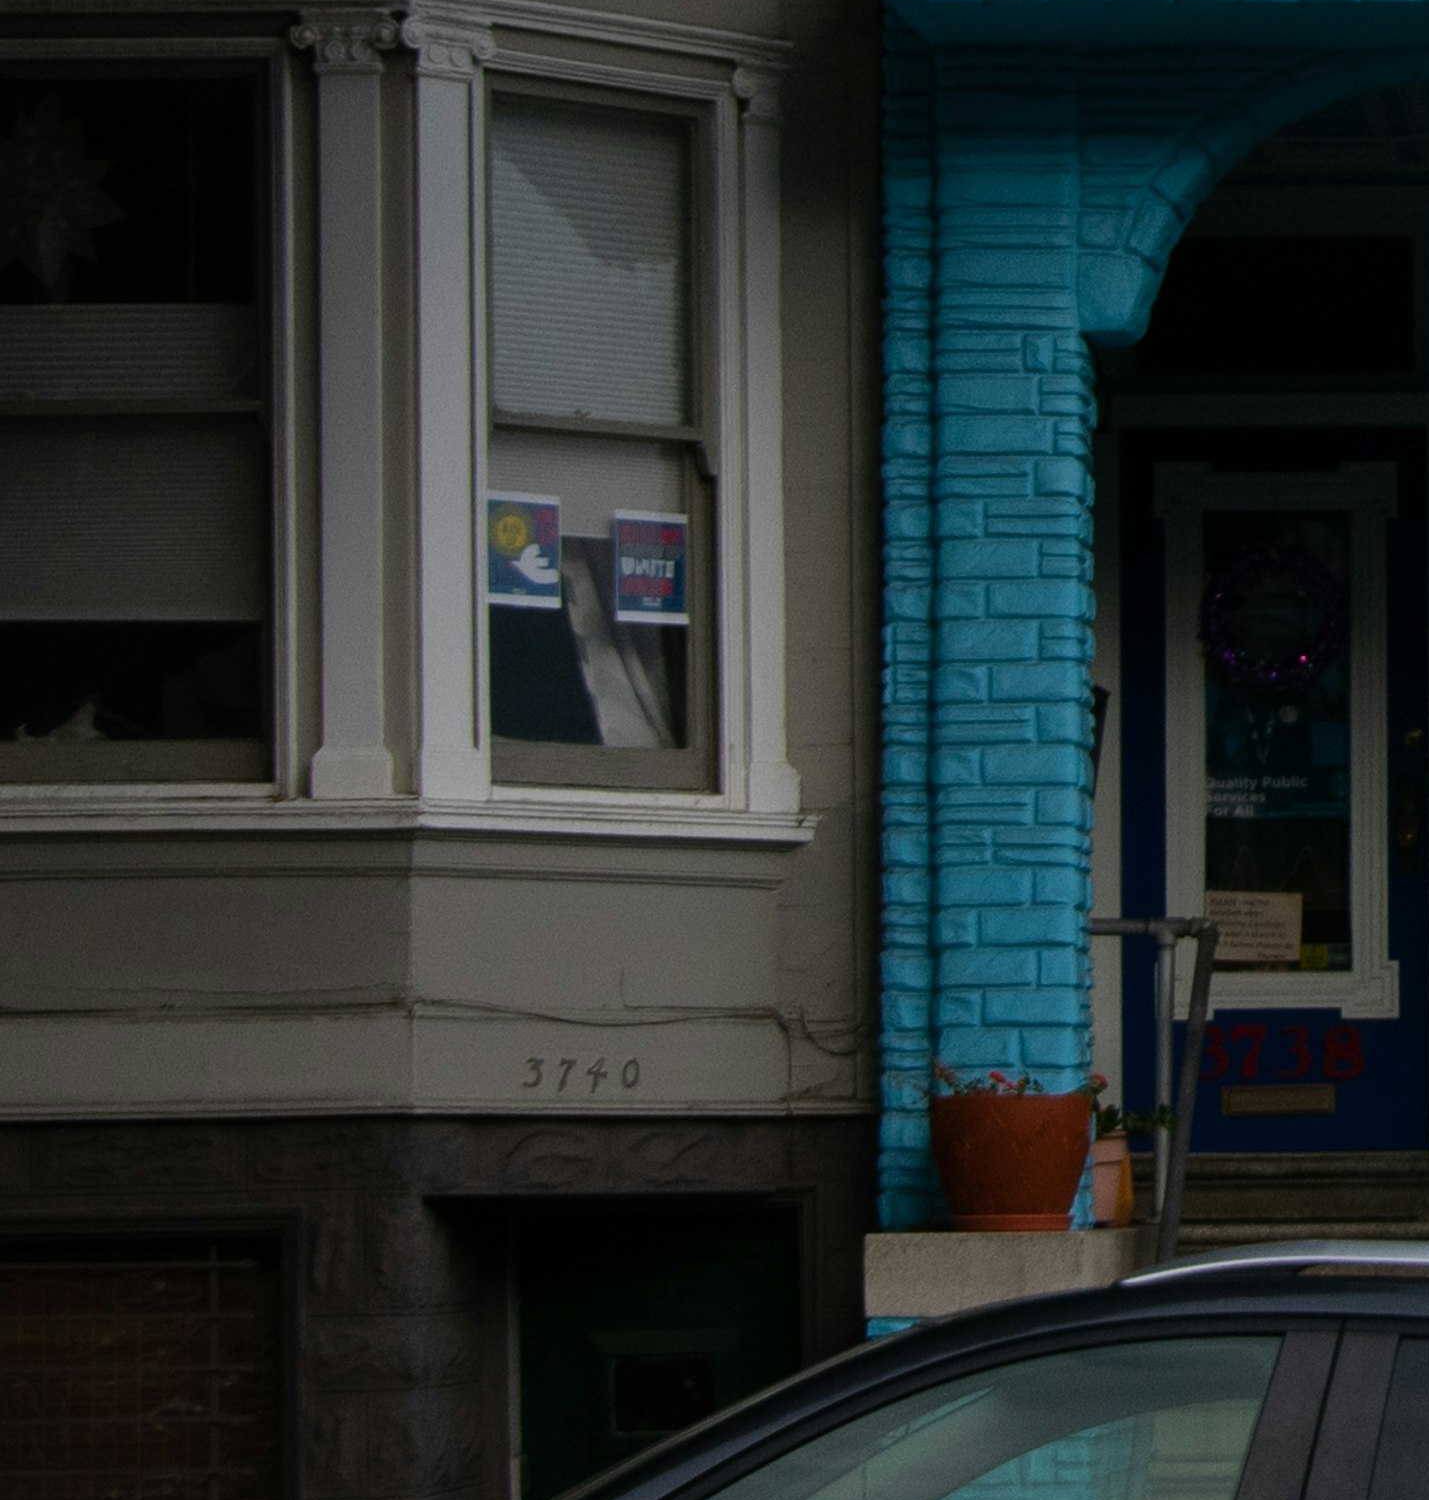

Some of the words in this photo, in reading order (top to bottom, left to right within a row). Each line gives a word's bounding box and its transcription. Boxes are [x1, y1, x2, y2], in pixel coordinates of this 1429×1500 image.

[1261, 775, 1310, 789] Public
[1233, 804, 1255, 817] All
[1200, 1022, 1365, 1081] 3738
[522, 1056, 641, 1094] 3740
